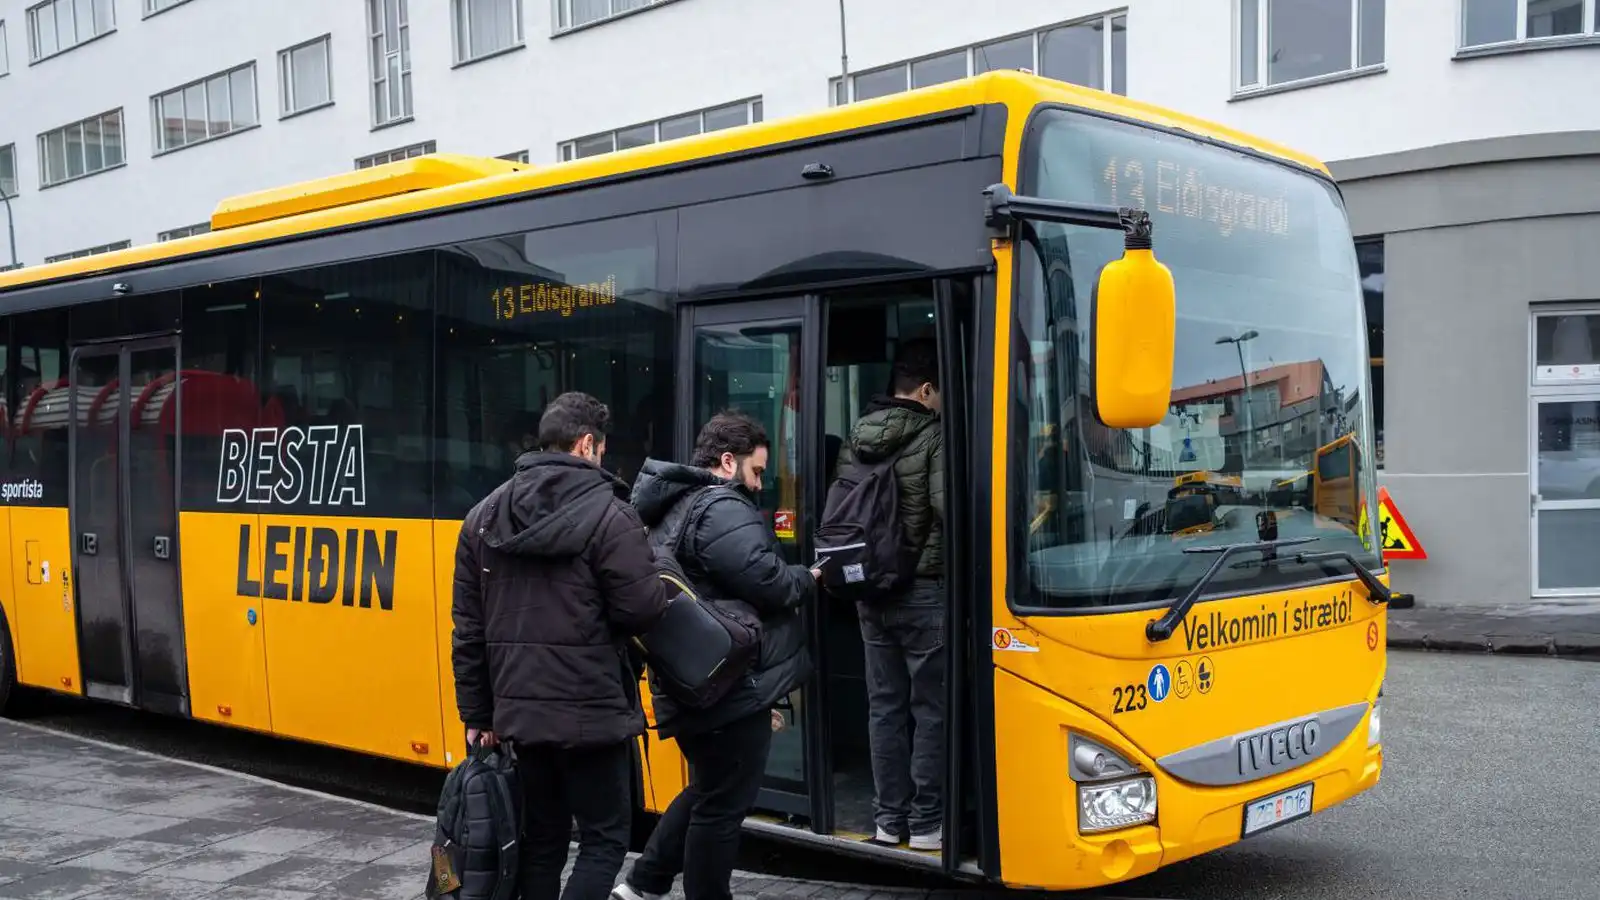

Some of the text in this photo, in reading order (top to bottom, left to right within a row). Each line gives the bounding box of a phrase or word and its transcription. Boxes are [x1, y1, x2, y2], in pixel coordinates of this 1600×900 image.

[1104, 156, 1288, 238] 13 Eiðisgrandi
[492, 274, 616, 319] 13 Eiðisgrandi
[1, 478, 43, 502] sportista
[217, 424, 366, 506] BESTA
[236, 524, 398, 611] LEIÐIN
[1182, 591, 1353, 651] Velkomin í strætó!
[1112, 684, 1147, 714] 223
[1237, 720, 1321, 776] IVECO
